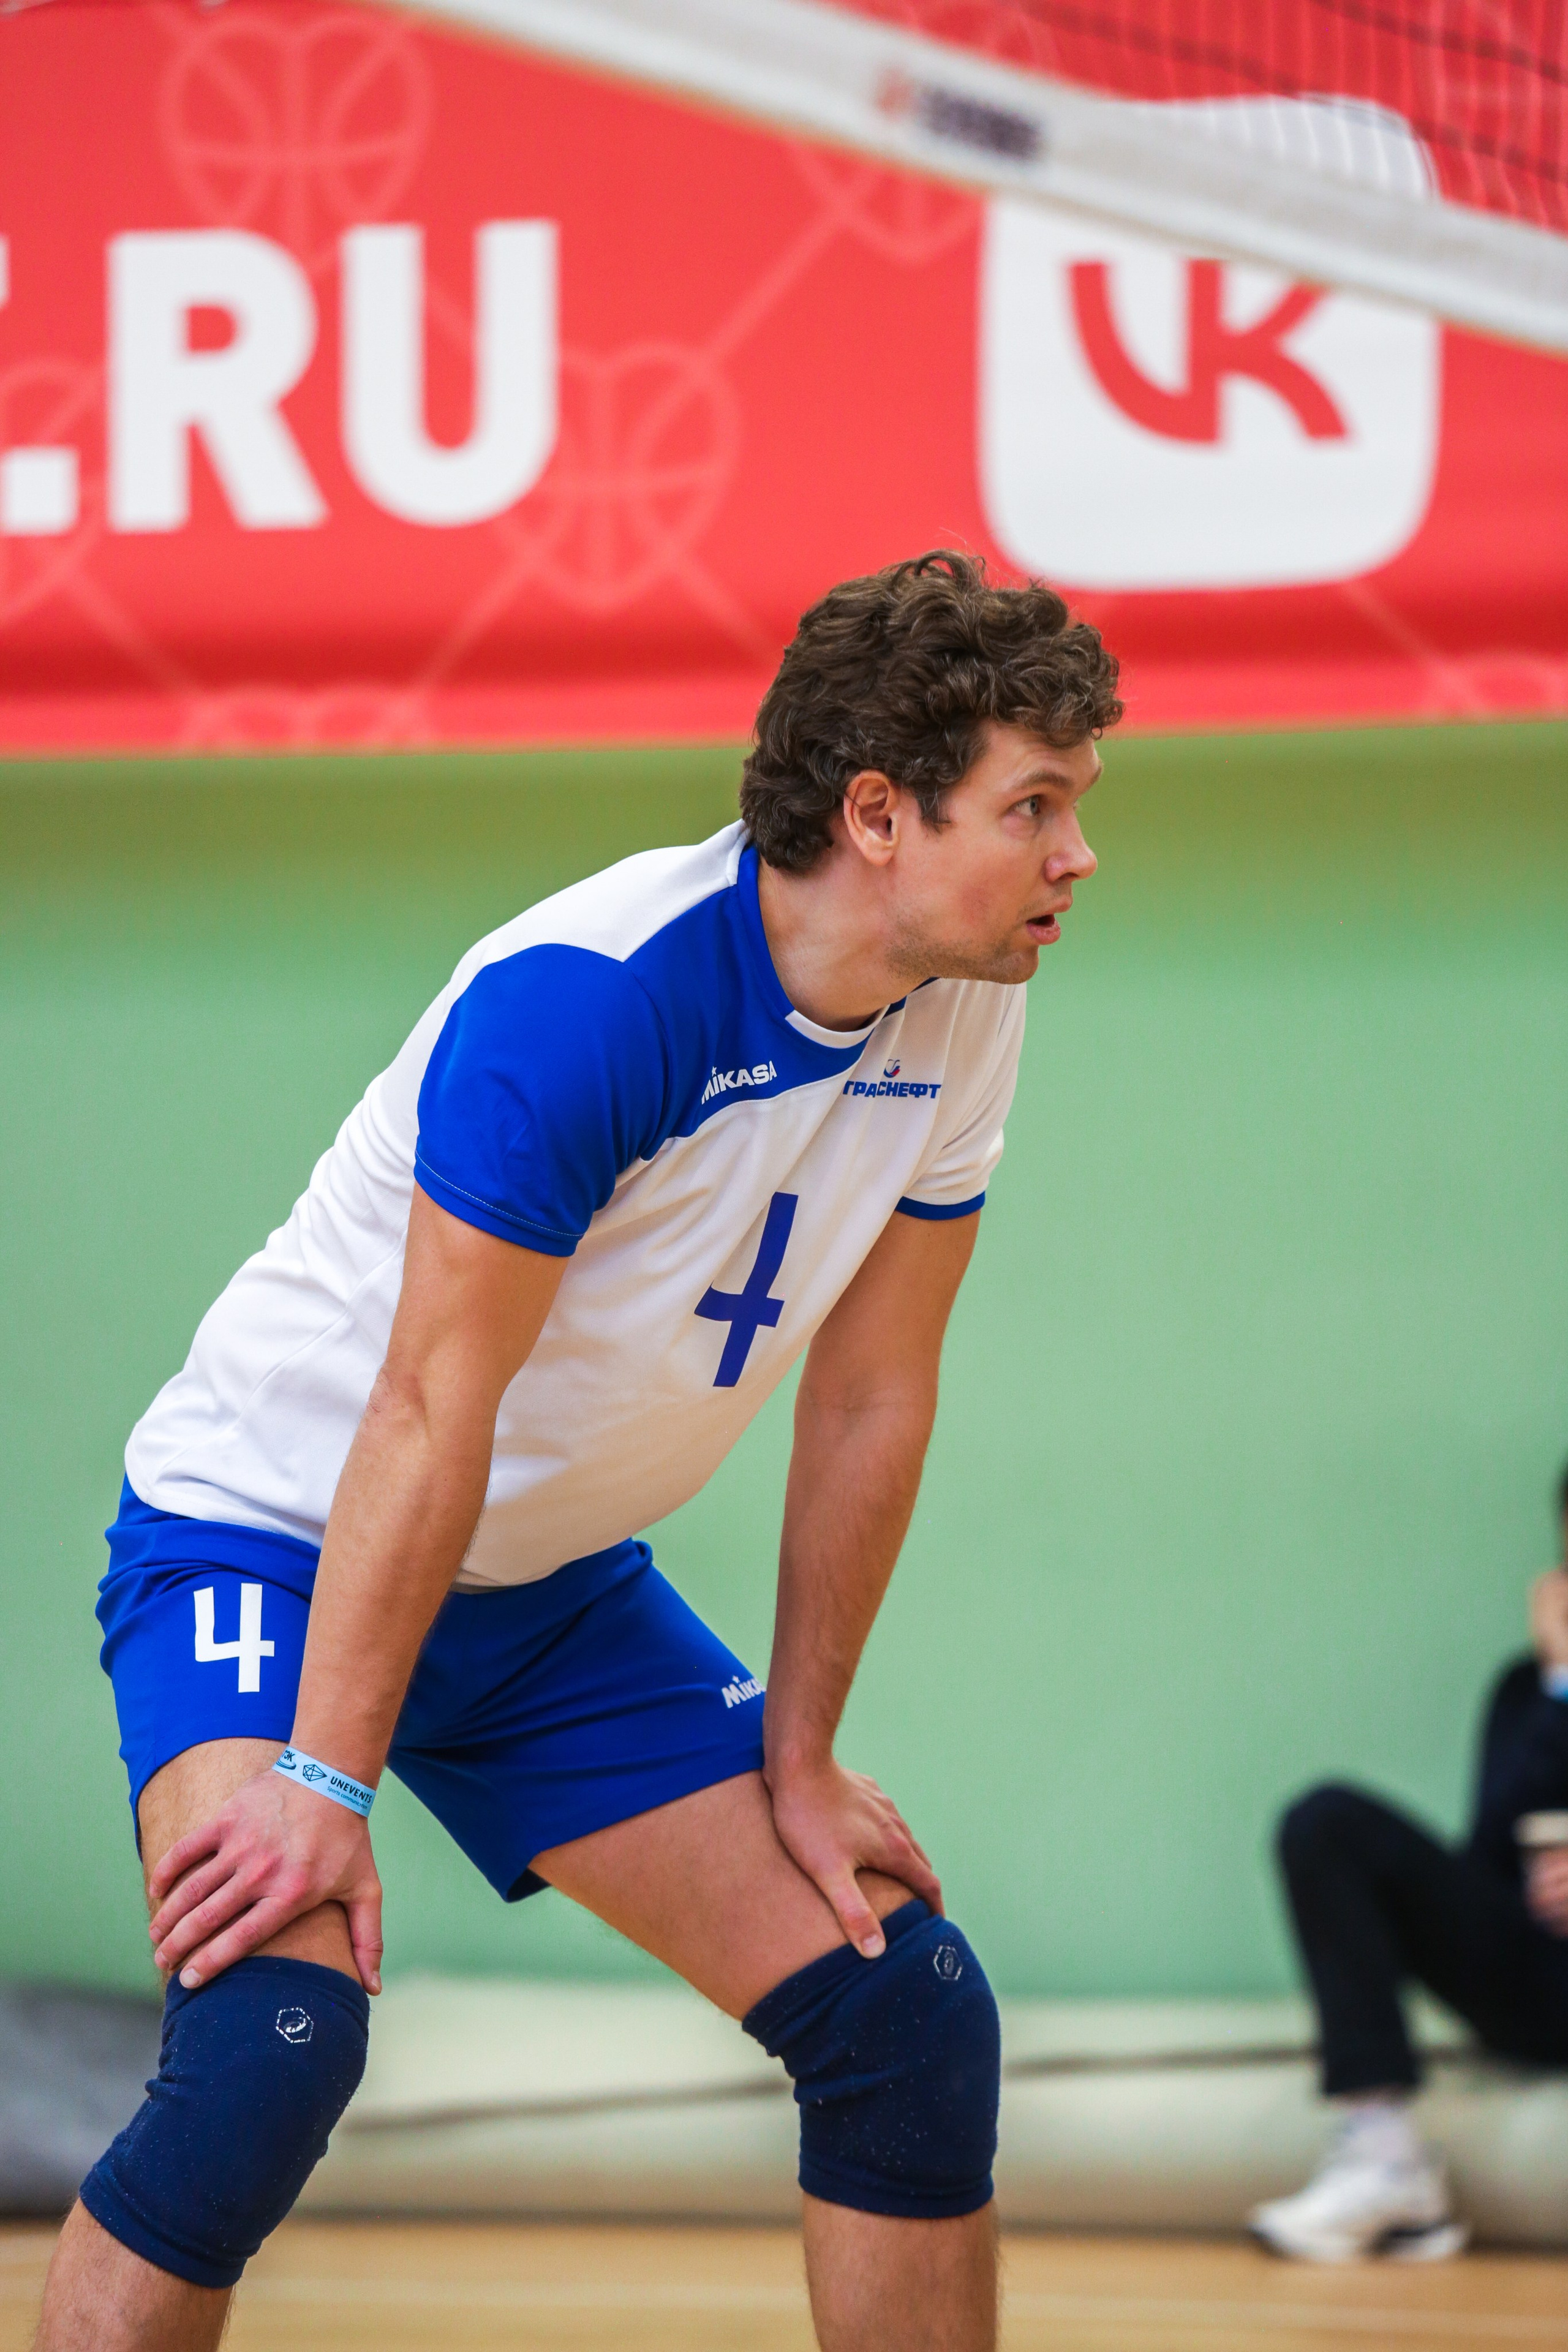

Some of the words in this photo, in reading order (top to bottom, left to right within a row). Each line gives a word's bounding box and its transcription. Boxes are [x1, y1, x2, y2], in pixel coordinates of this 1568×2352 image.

[0, 217, 560, 537] .RU
[701, 1060, 777, 1105] MIKASA
[694, 1191, 799, 1387] 4
[194, 1583, 274, 1693] 4
[327, 1786, 341, 1796] Sports
[330, 1776, 372, 1803] UNEVENTS
